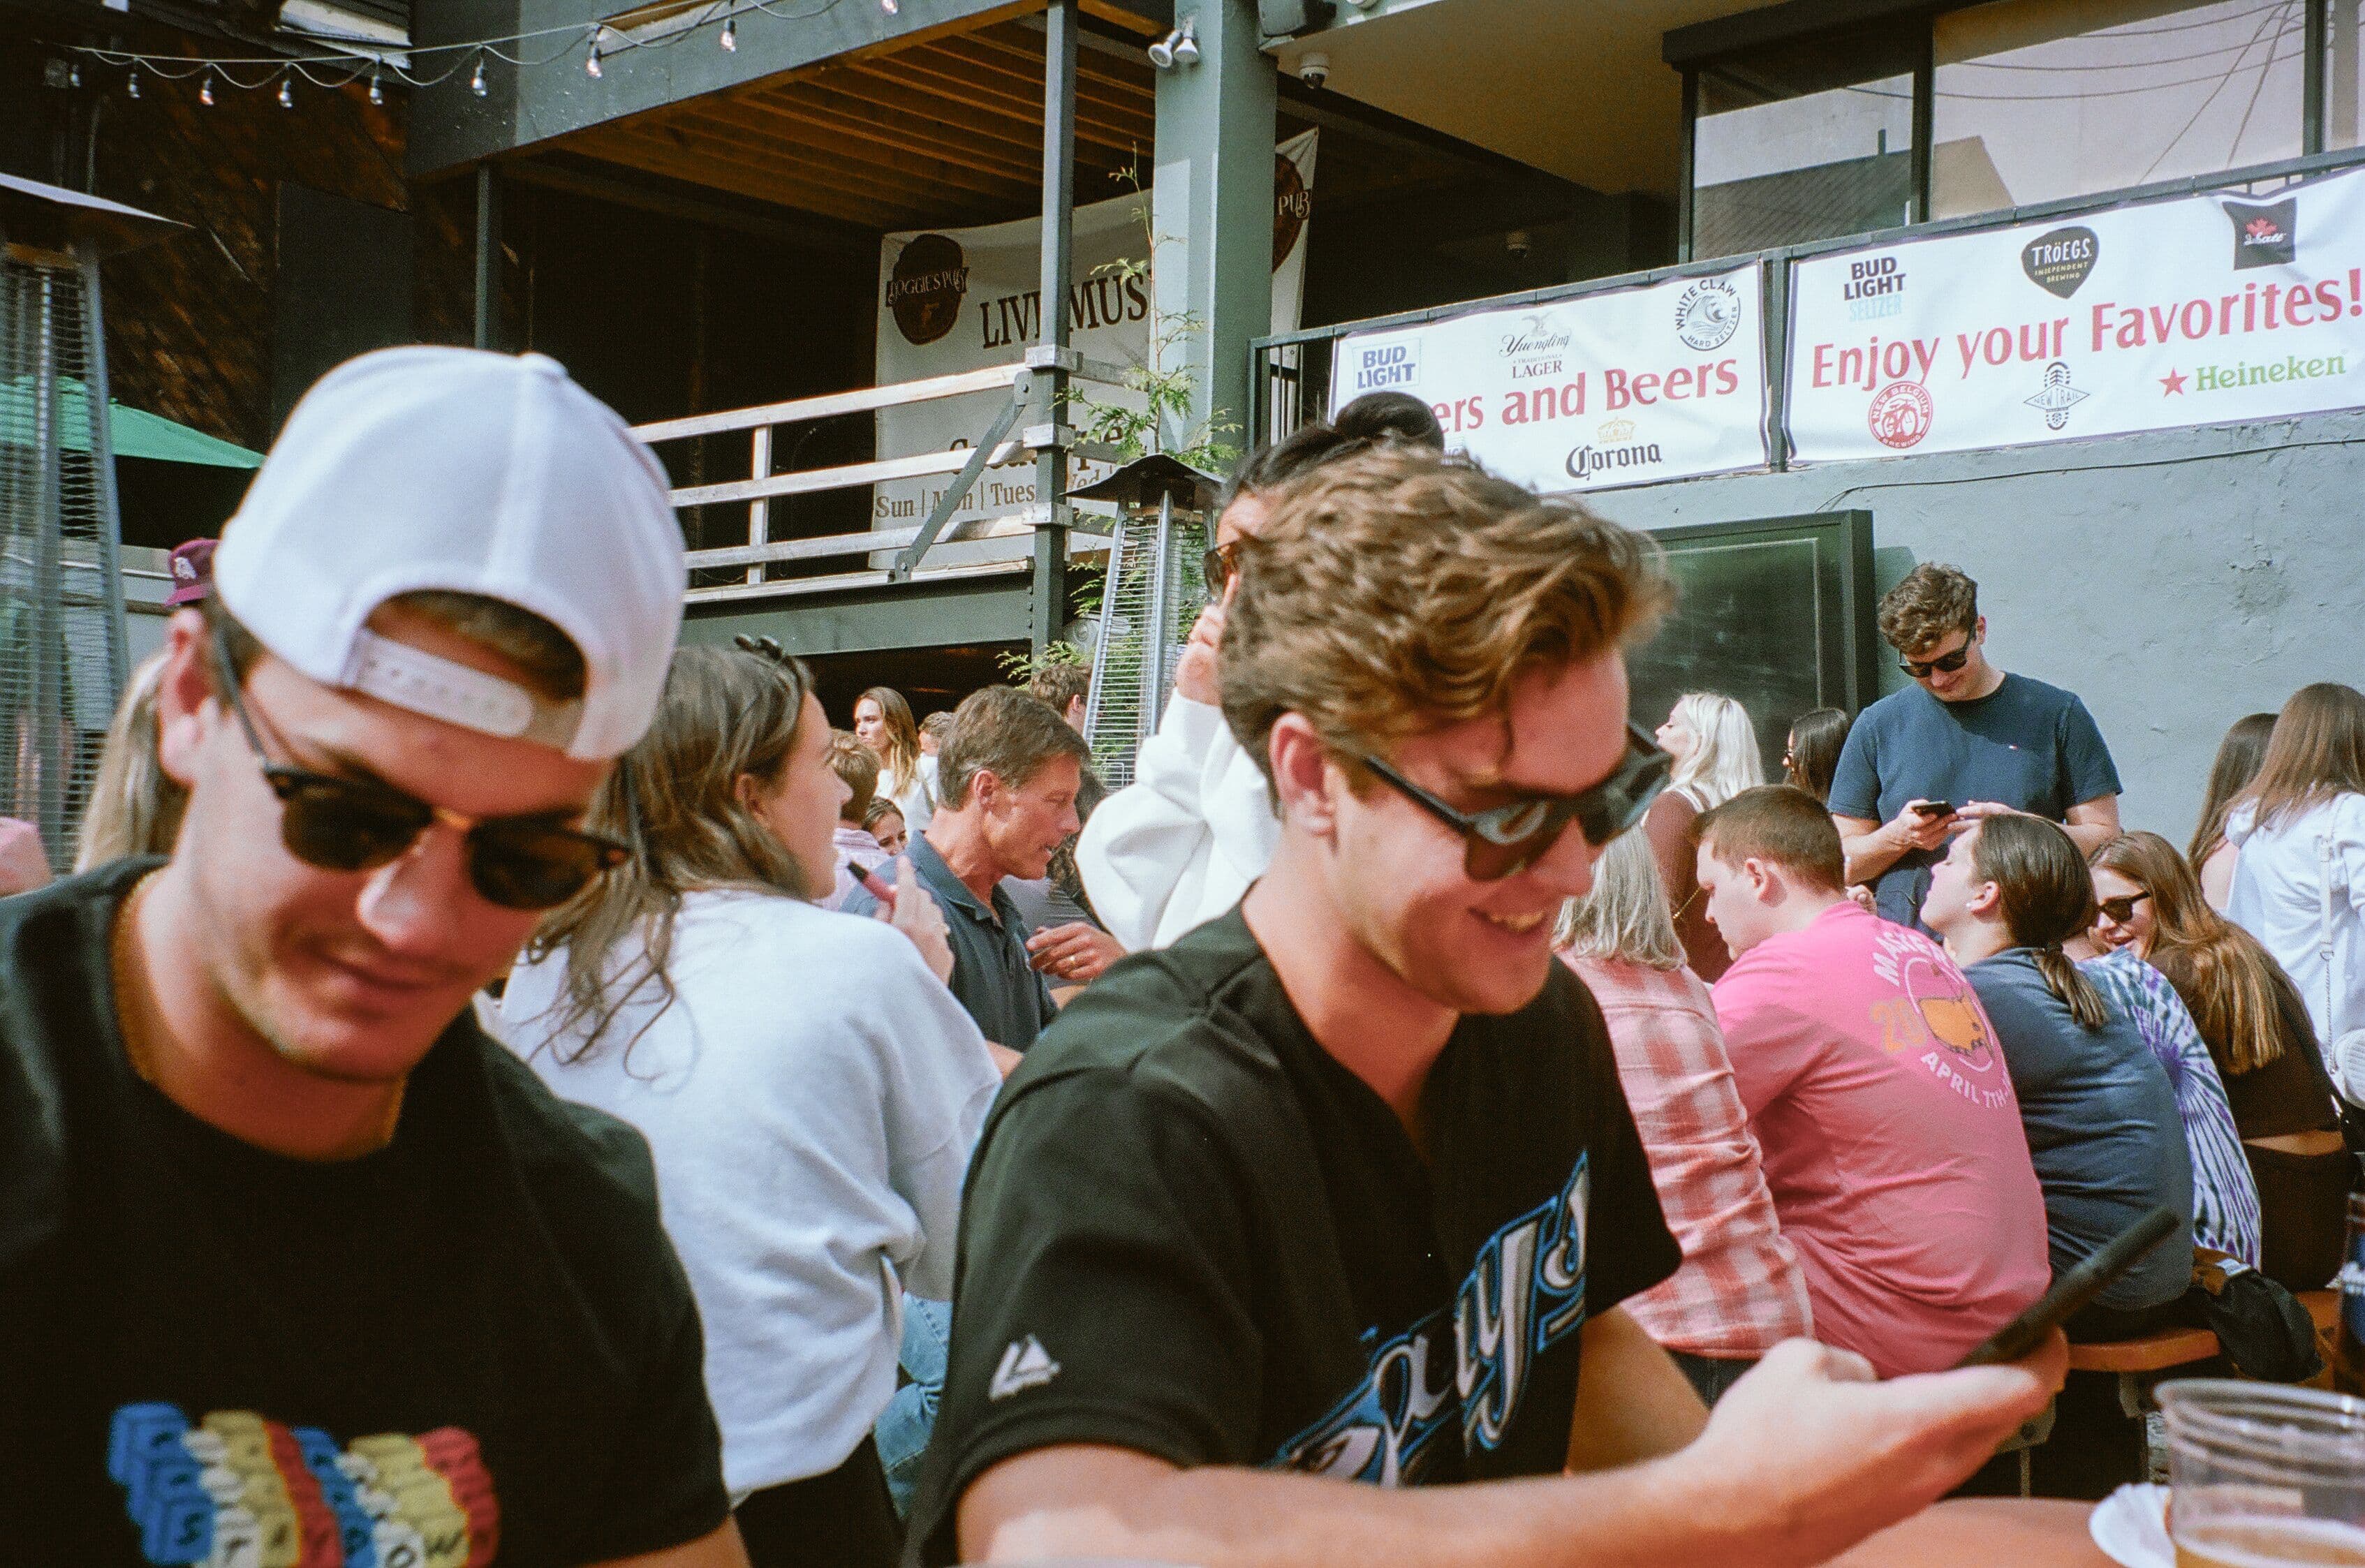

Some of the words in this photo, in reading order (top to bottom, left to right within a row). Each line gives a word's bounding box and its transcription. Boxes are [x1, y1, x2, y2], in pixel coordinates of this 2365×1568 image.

[1279, 191, 1310, 219] PUB
[2031, 237, 2091, 266] TRÖEGS
[1850, 256, 1897, 280] BUD
[1844, 274, 1906, 301] LIGHT
[1675, 286, 1698, 330] WHITE
[1700, 279, 1737, 297] CLAW
[1849, 293, 1902, 322] SELTZER
[1687, 335, 1711, 347] HARD
[1715, 306, 1737, 344] SELTZER
[1812, 336, 1940, 392] Enjoy
[1957, 316, 2070, 380] your
[2091, 268, 2363, 353] Favorites!
[1362, 346, 1407, 369] BUD
[1498, 331, 1571, 357] Yuengling
[1357, 362, 1416, 389] LIGHT
[1512, 360, 1563, 378] LAGER
[2196, 355, 2347, 392] Heineken
[1433, 394, 1484, 434] ers
[1501, 371, 1586, 426] and
[1604, 358, 1739, 412] Beers
[1872, 394, 1889, 419] NEW
[1891, 385, 1929, 414] BELGIUM
[1565, 443, 1663, 482] Corona
[876, 495, 915, 519] Sun
[990, 482, 1036, 507] Tues
[1921, 1051, 1979, 1104] APRIL
